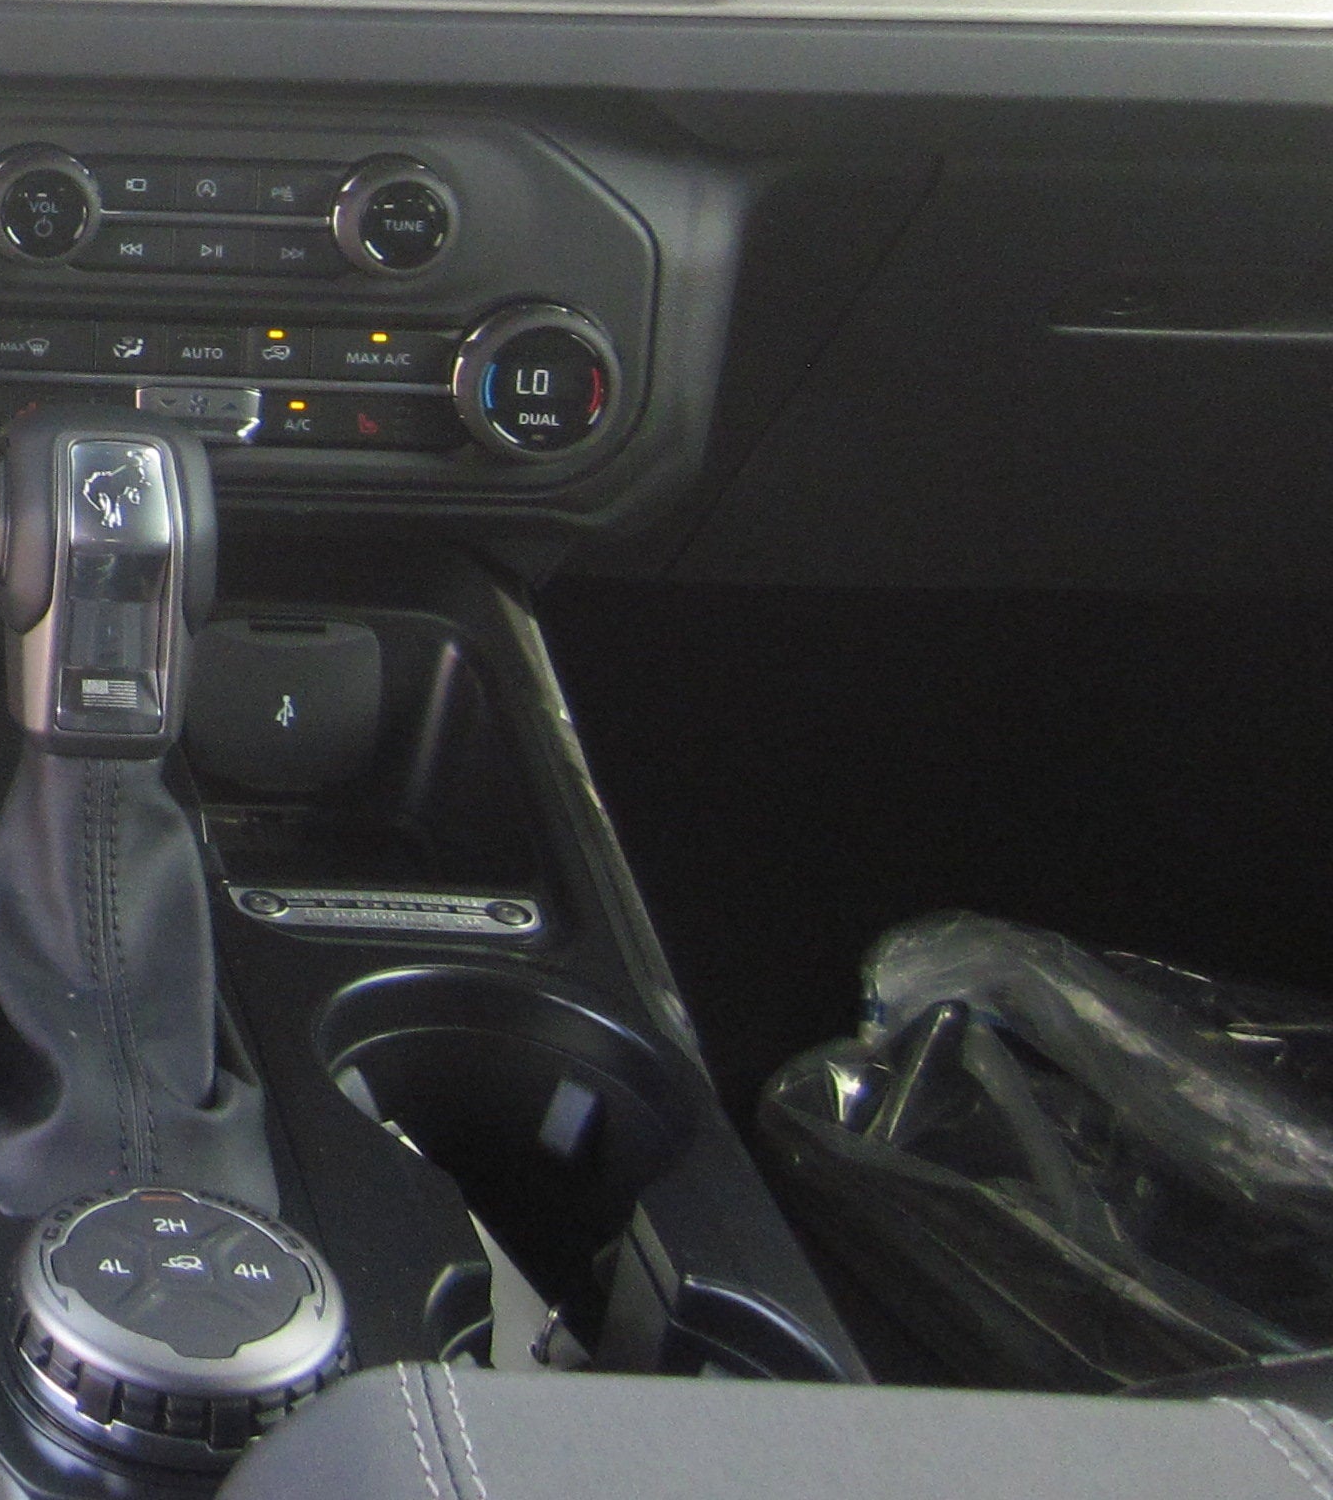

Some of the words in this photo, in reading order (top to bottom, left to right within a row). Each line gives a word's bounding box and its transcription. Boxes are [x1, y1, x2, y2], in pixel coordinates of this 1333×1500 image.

[29, 201, 59, 215] VOL
[383, 219, 425, 233] TUNE
[181, 347, 224, 361] AUTO
[346, 351, 380, 366] MAX
[383, 352, 412, 366] A/C
[284, 418, 311, 433] A/C
[518, 412, 560, 427] DUAL
[153, 1218, 189, 1234] 2H
[98, 1259, 131, 1275] 4L
[233, 1263, 272, 1280] 4H
